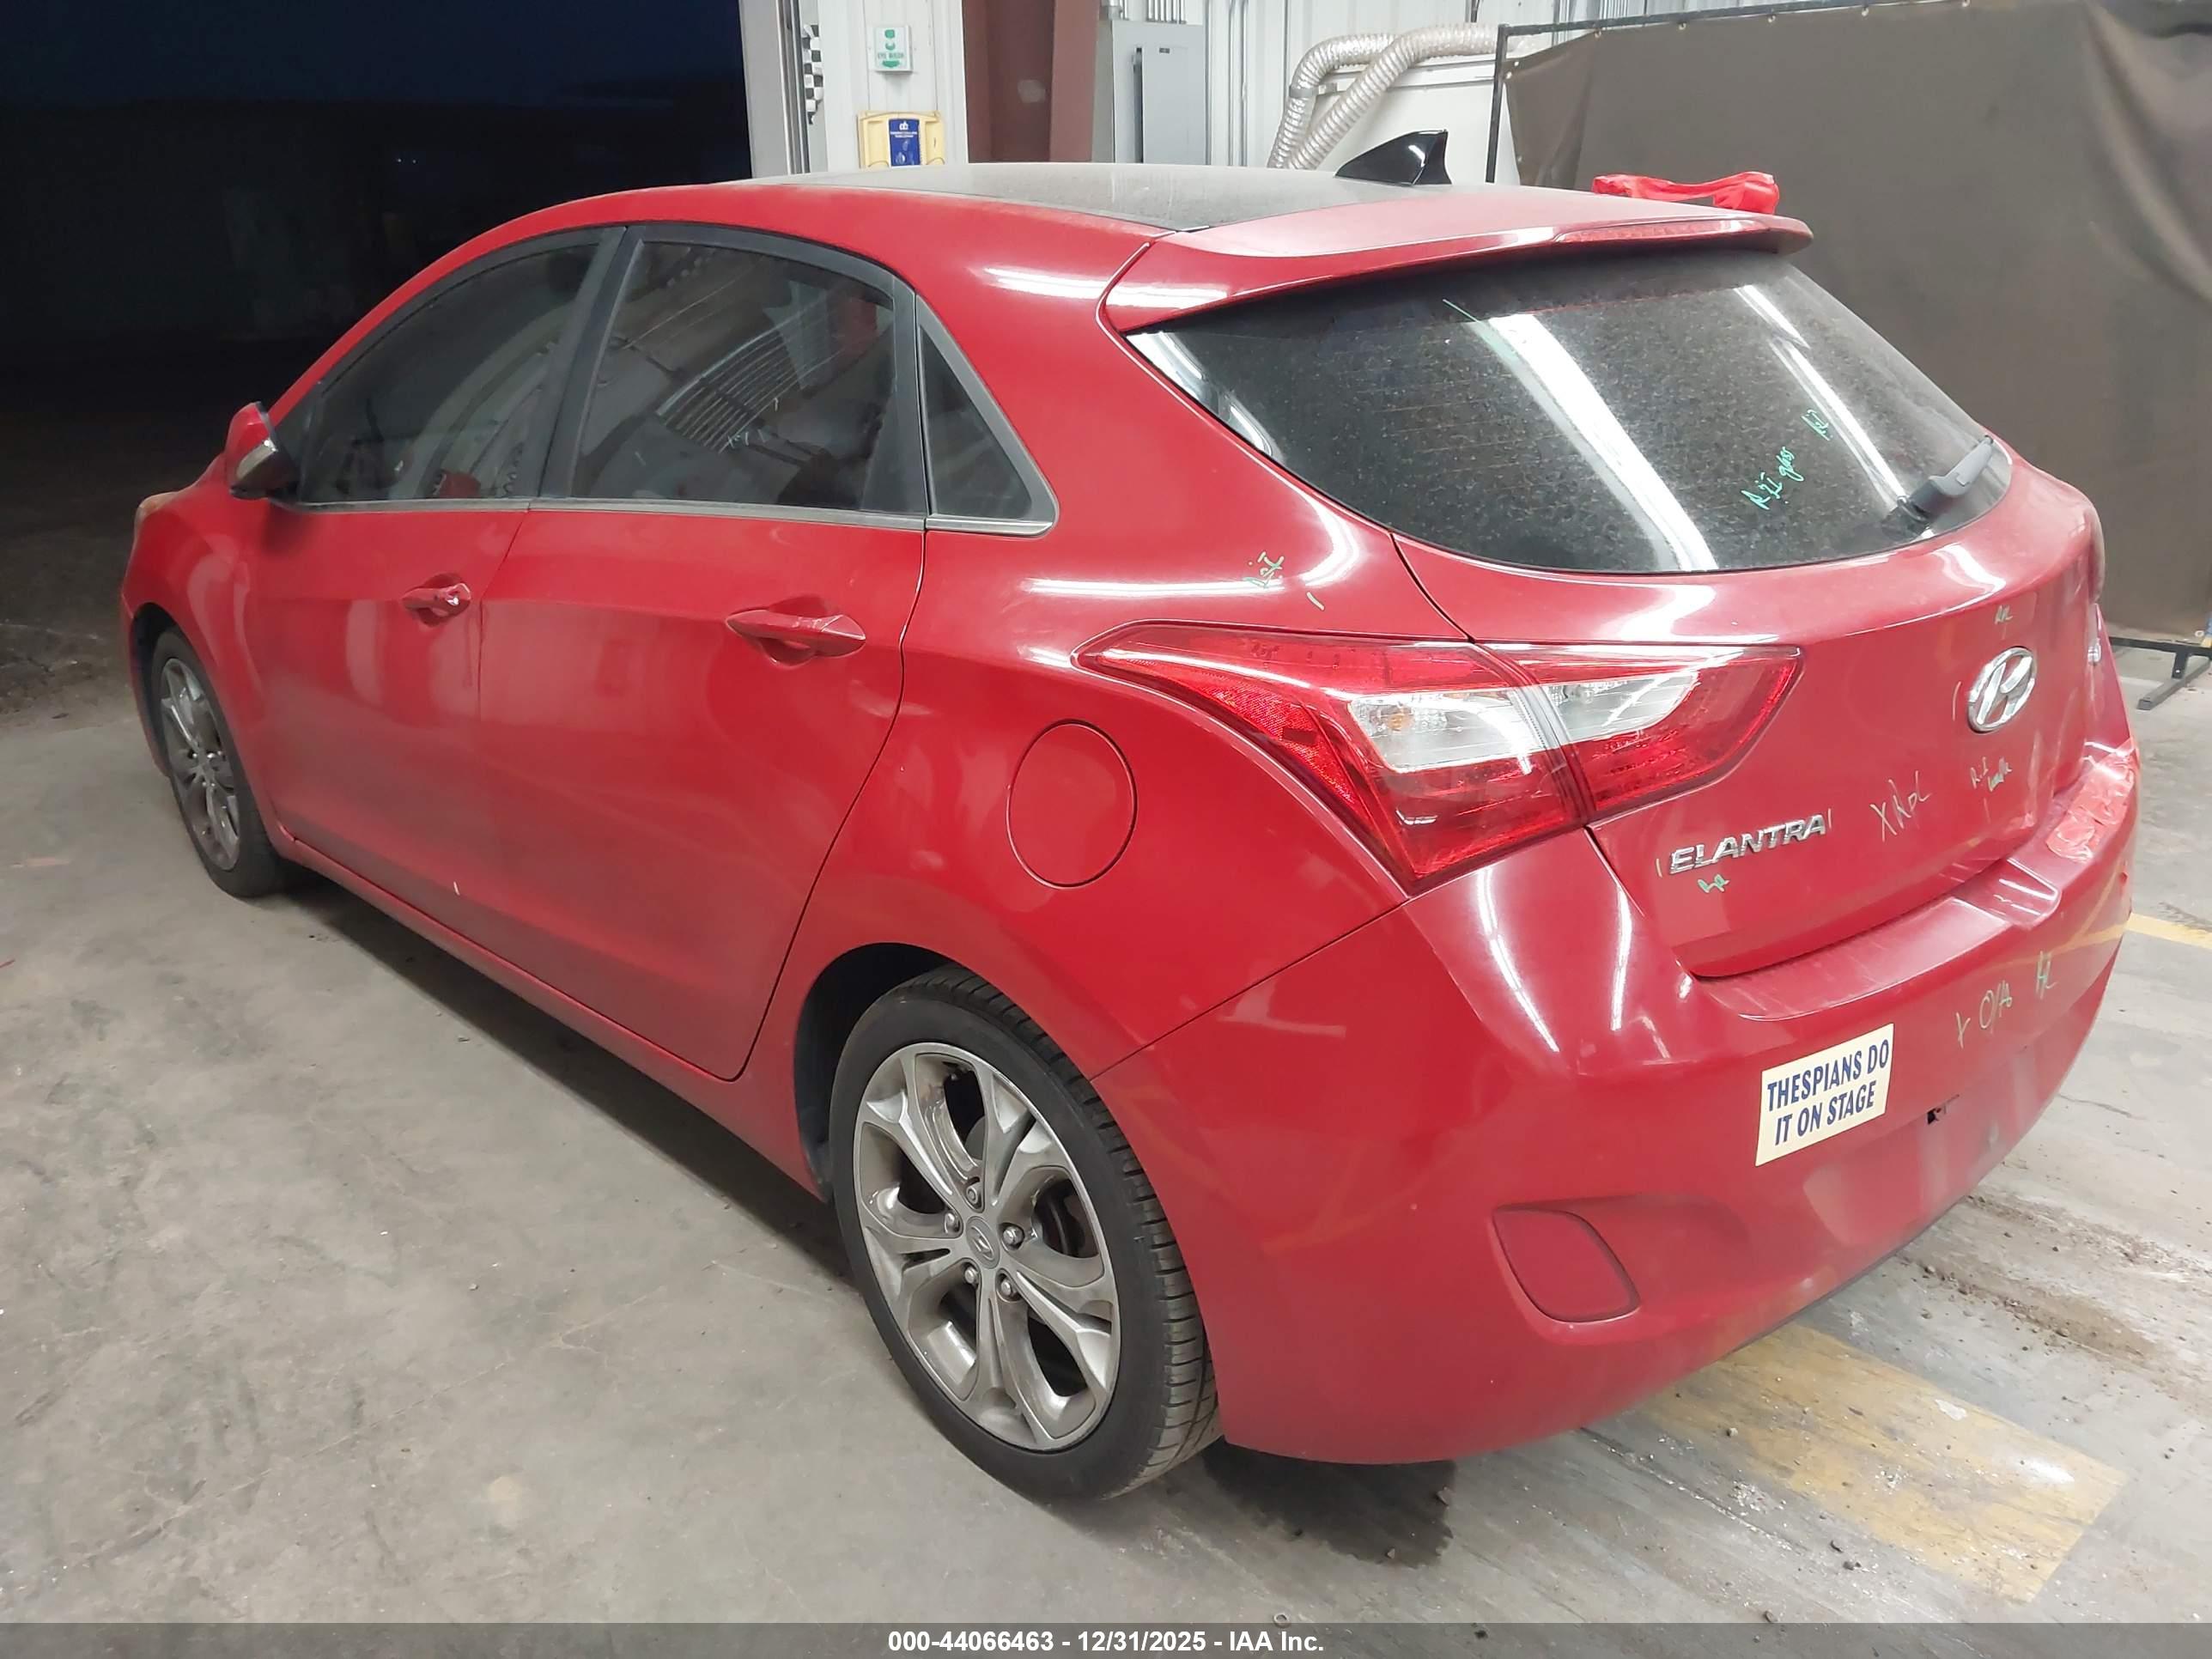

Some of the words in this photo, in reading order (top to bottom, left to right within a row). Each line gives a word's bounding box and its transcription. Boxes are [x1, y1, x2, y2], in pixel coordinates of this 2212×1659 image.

[1668, 813, 1826, 875] ELANTRA
[1767, 1050, 1862, 1112] THESPIANS
[1867, 1039, 1889, 1074] DO
[1774, 1114, 1793, 1146] IT
[1797, 1103, 1823, 1137] ON
[1826, 1079, 1876, 1126] STAGE
